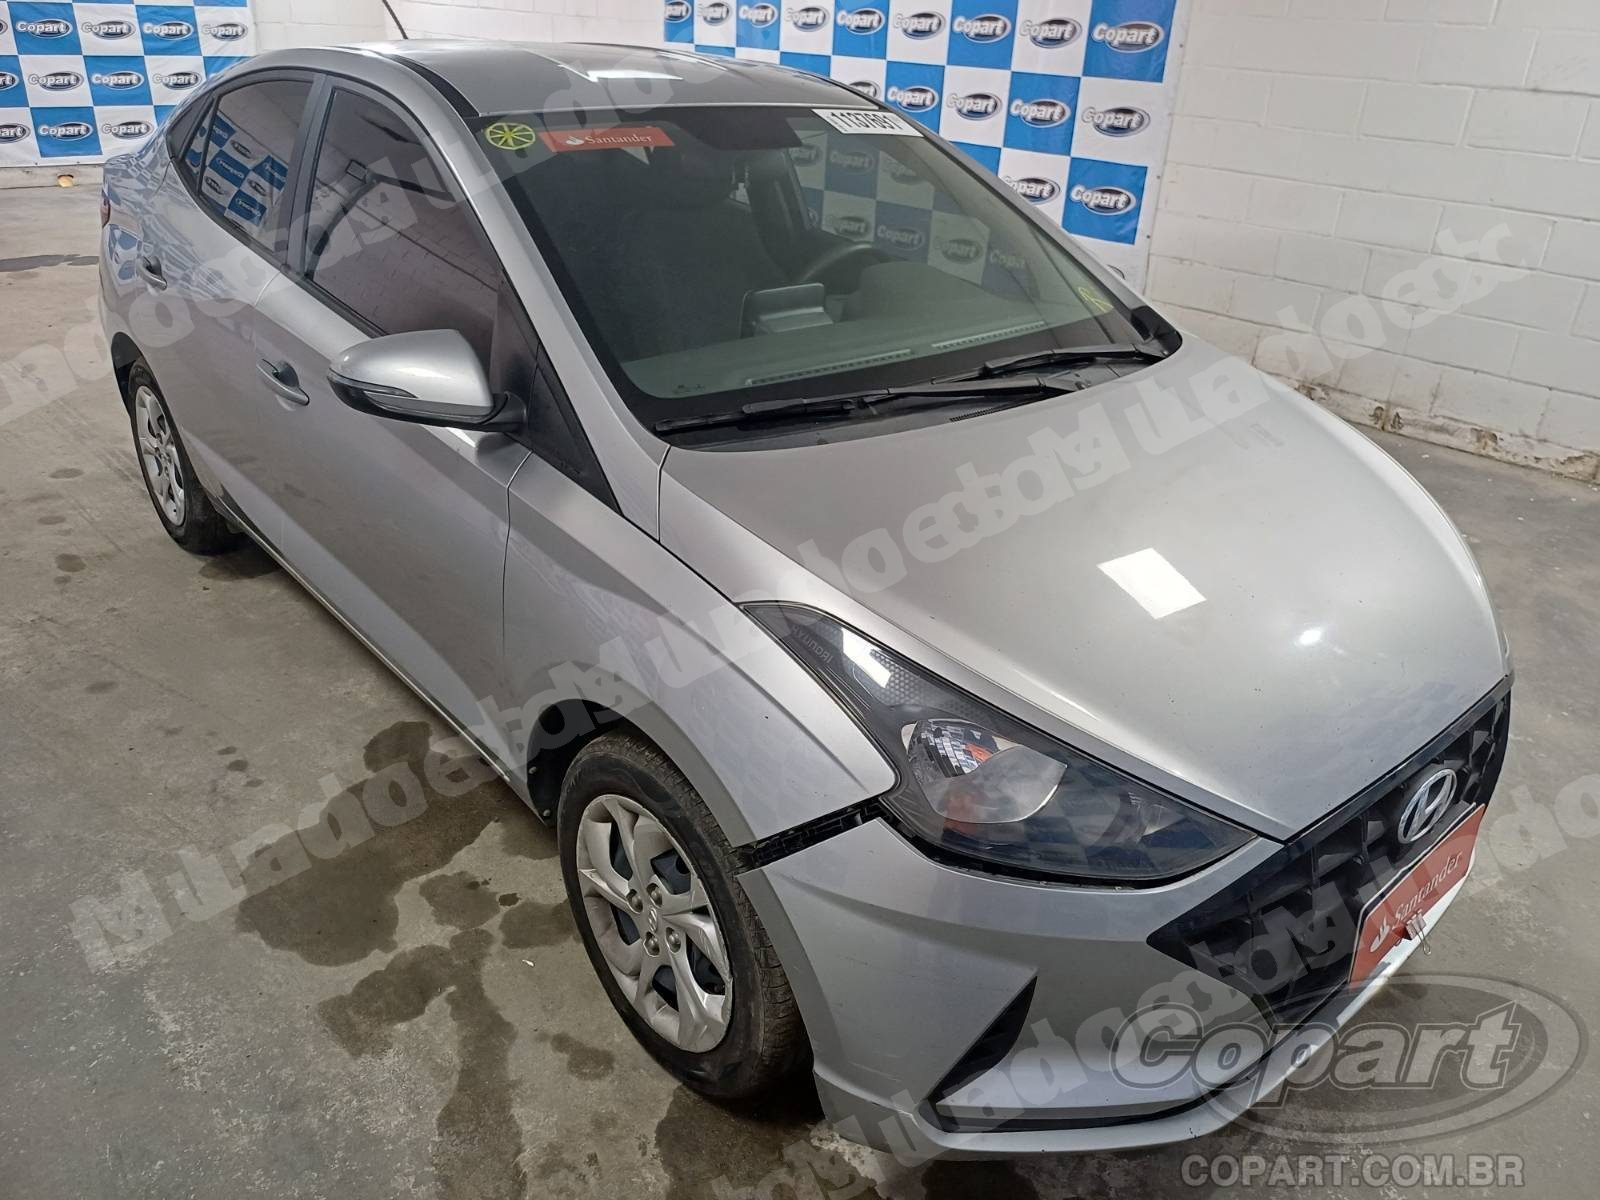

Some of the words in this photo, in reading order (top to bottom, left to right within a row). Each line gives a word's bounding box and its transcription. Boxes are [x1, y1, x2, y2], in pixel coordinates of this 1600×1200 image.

[664, 4, 687, 19] part
[836, 10, 881, 31] Copart
[16, 20, 66, 34] Copart
[82, 21, 129, 35] Copart
[143, 22, 188, 36] Copart
[202, 24, 242, 37] Copart
[893, 13, 939, 33] Copart
[953, 15, 1003, 36] Copart
[1020, 20, 1072, 42] Copart
[1092, 22, 1156, 45] Copart
[28, 73, 77, 86] Copart
[91, 73, 138, 85] Copart
[152, 73, 196, 86] Copart
[887, 86, 934, 106] Copart
[947, 92, 998, 115] Copart
[1010, 99, 1066, 122] Copart
[1083, 107, 1143, 131] Copart
[102, 123, 146, 136] Copart
[831, 111, 903, 130] 1137691
[38, 124, 86, 137] Copart
[585, 133, 652, 144] Santander
[1071, 184, 1129, 209] Copart
[1394, 850, 1463, 921] Santander
